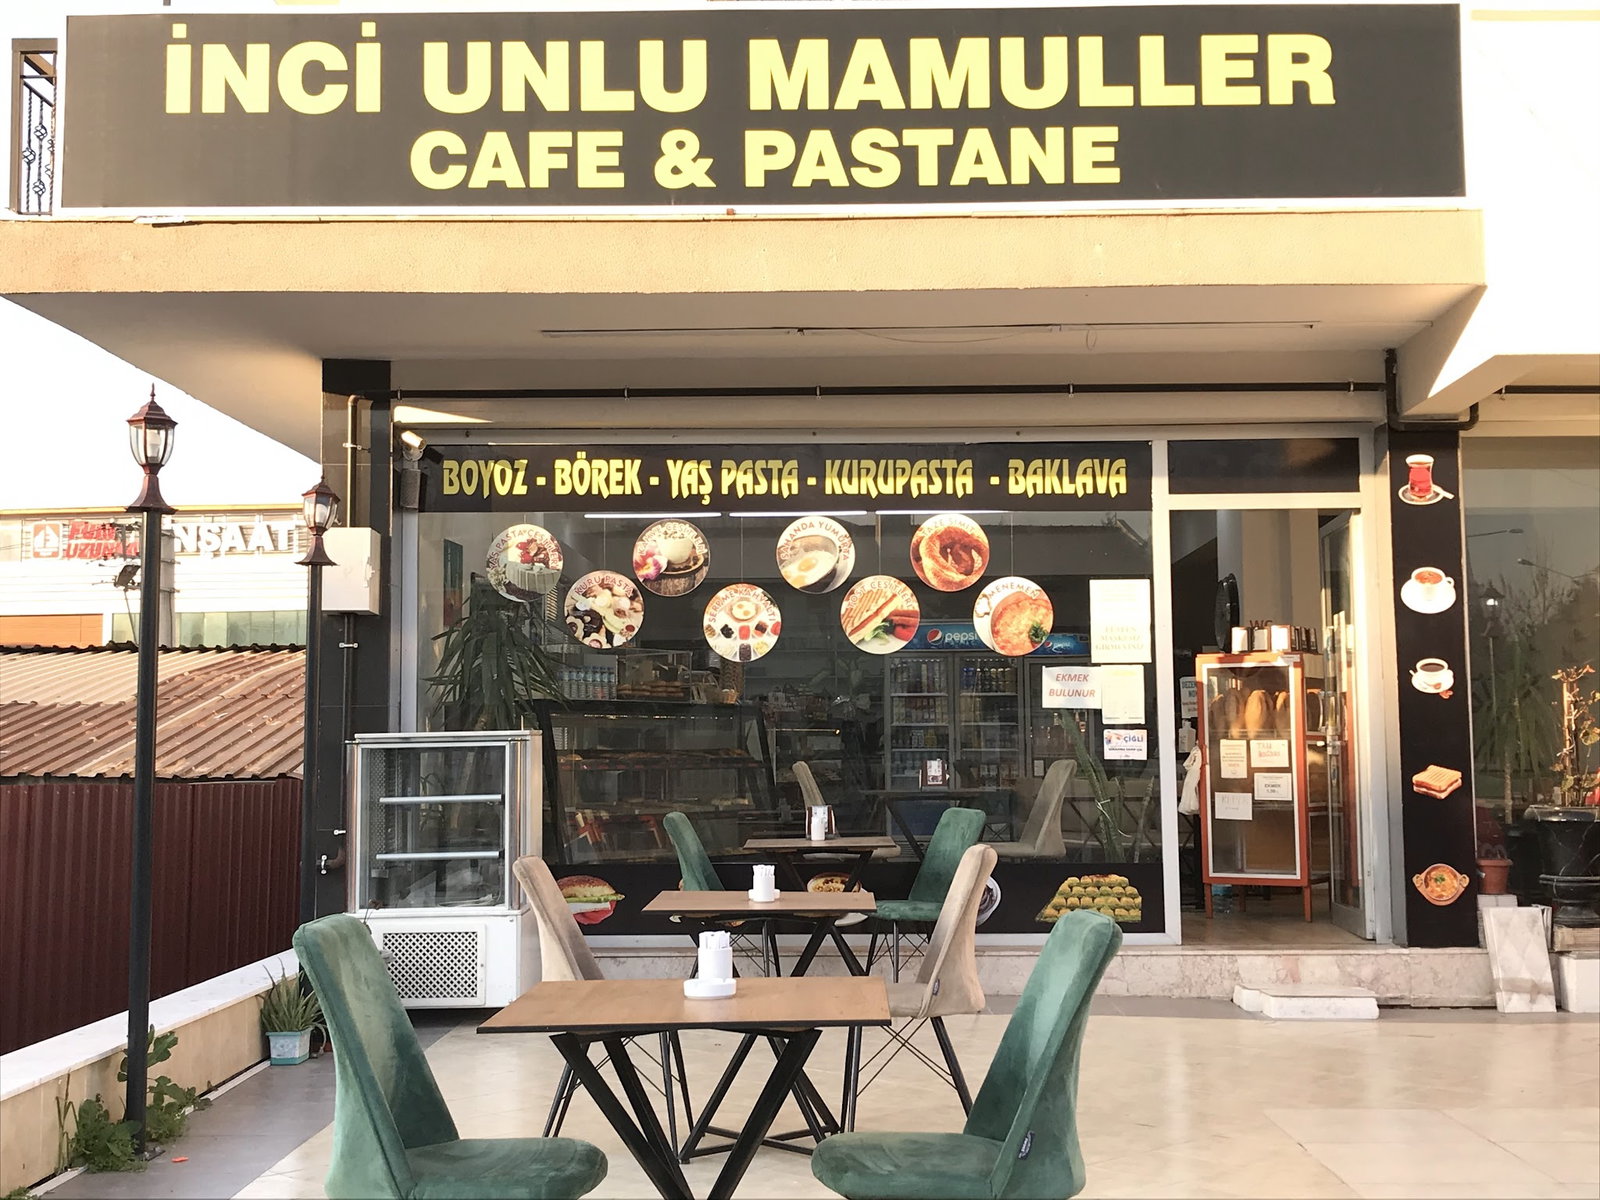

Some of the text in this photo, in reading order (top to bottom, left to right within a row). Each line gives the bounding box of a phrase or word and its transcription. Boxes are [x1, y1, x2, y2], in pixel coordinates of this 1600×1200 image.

[164, 22, 1336, 115] İNCİ UNLU MAMULLER
[410, 126, 1121, 190] CAFE & PASTANE
[442, 459, 529, 500] BOYOZ
[554, 451, 643, 500] BÖREK
[666, 459, 714, 506] YAŞ
[721, 459, 800, 499] PASTA
[825, 458, 974, 499] KURUPASTA
[1008, 458, 1128, 499] BAKLAVA
[496, 530, 524, 551] PASTA
[781, 521, 815, 560] SAHANDA
[575, 575, 634, 597] KURU PASTA
[988, 582, 1040, 598] MENEMEN
[709, 590, 736, 623] SERPME
[945, 632, 978, 643] pepsi
[1055, 673, 1089, 683] EKMEK
[1048, 688, 1096, 698] BULUNUR
